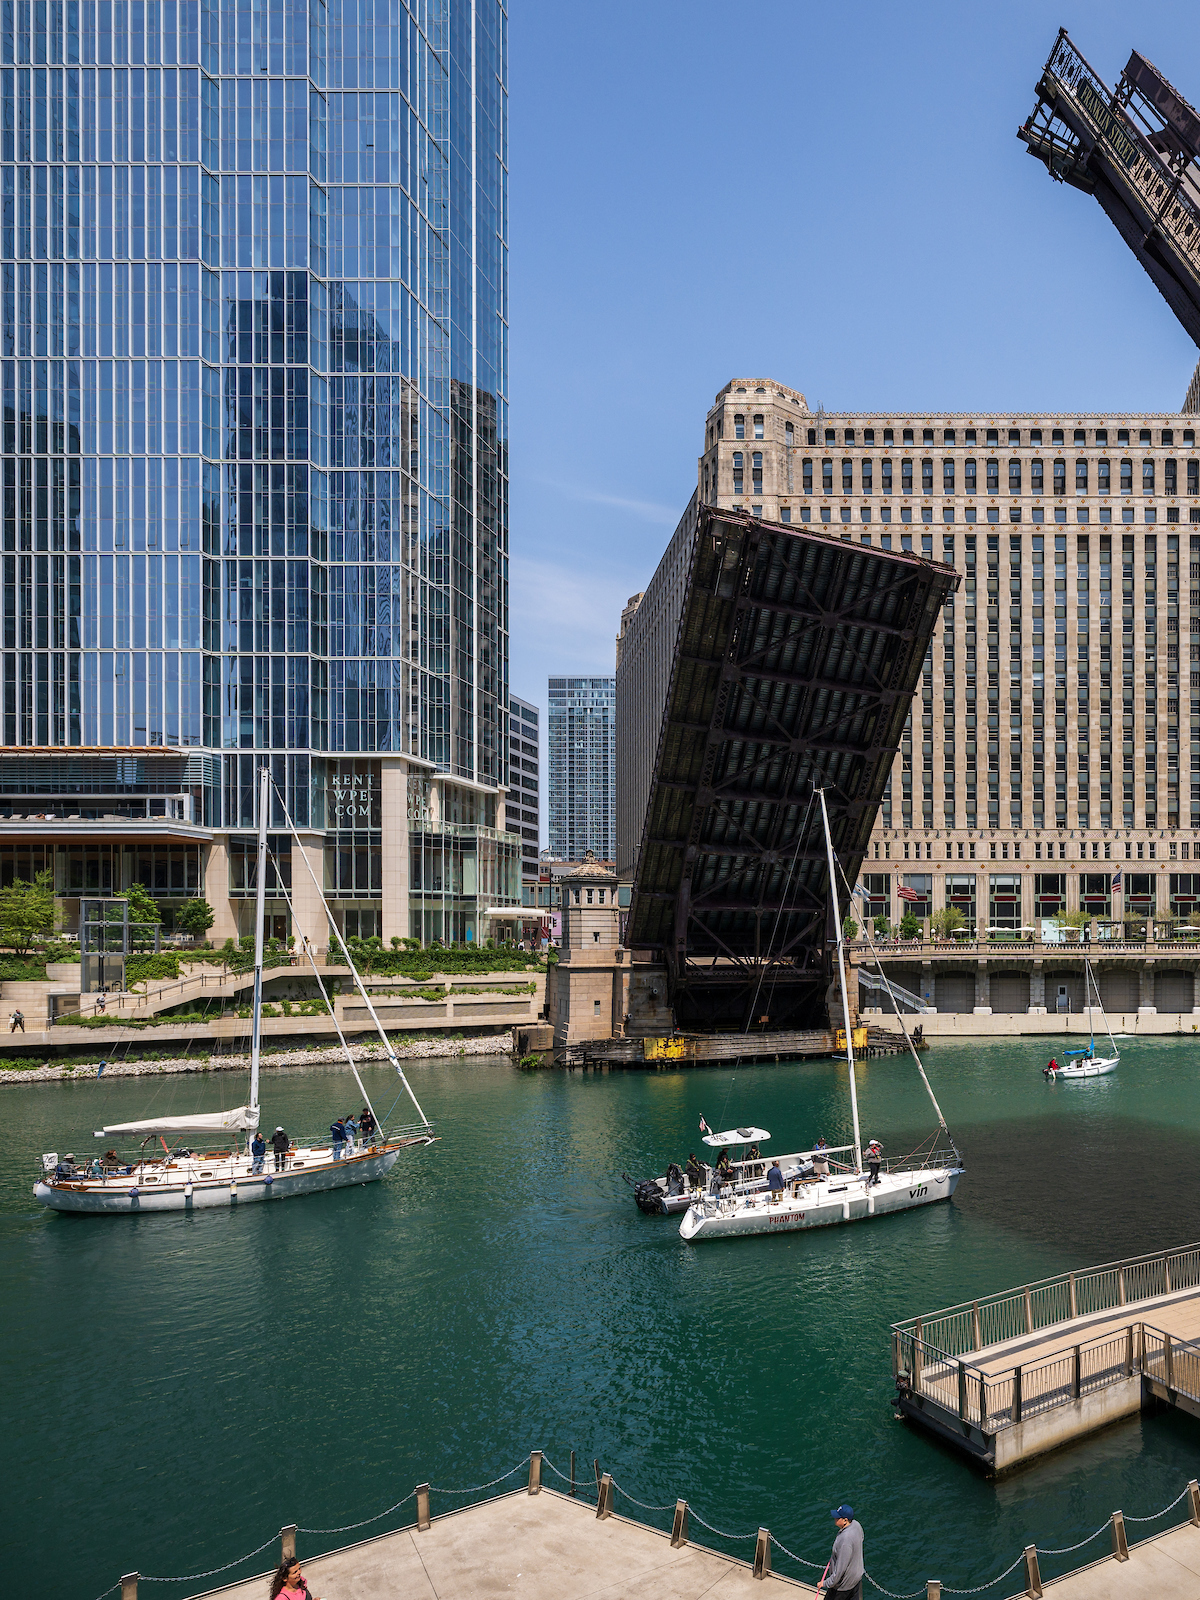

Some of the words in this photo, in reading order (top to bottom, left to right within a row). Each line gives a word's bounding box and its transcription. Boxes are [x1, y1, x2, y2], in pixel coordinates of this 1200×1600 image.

[1080, 85, 1112, 132] FRANKLIN
[1108, 124, 1135, 163] STREET
[331, 774, 375, 785] RENT
[407, 776, 430, 793] RENT
[333, 790, 374, 801] WPE.
[334, 804, 371, 816] COM
[909, 1183, 928, 1199] vin
[768, 1212, 806, 1225] PHANTOM
